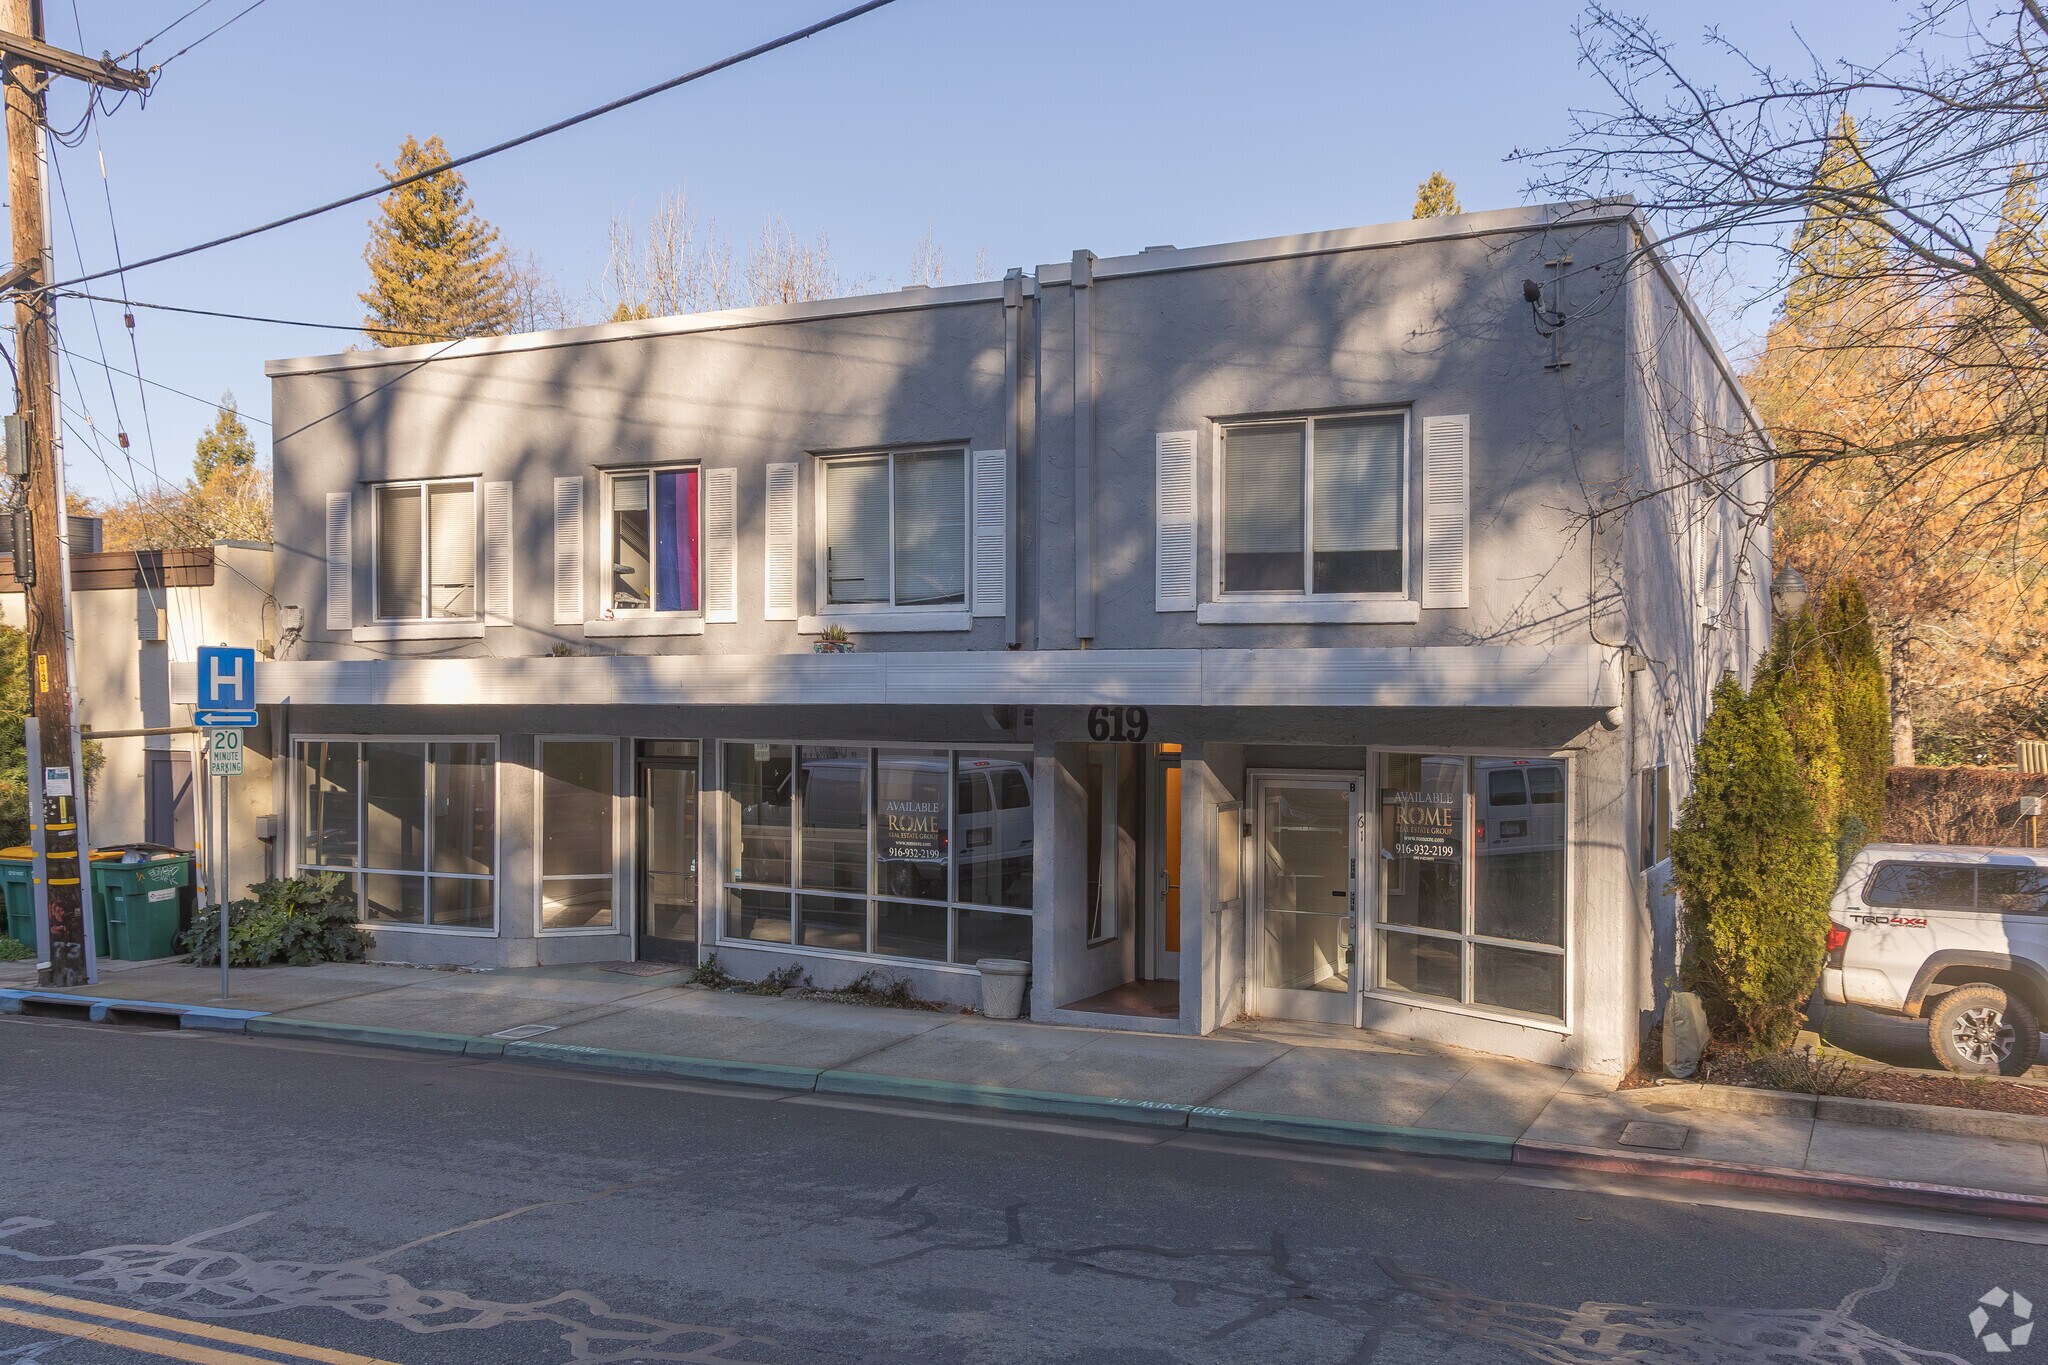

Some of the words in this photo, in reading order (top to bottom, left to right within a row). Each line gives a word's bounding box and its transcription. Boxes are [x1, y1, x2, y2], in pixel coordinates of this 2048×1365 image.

[210, 656, 243, 701] H
[1088, 705, 1148, 742] 619
[214, 732, 239, 749] 20
[213, 751, 239, 761] MINUTE
[211, 762, 241, 772] PARKING
[1349, 783, 1356, 792] B
[1393, 791, 1454, 804] AVAILABLE
[886, 801, 940, 813] AVAILABLE
[1396, 806, 1453, 827] ROME
[888, 814, 939, 833] ROME
[1431, 827, 1453, 835] GROUP
[888, 846, 940, 859] 916-932-2199
[1395, 843, 1454, 857] 916-932-2199
[1849, 914, 1890, 926] TRD
[1136, 1100, 1177, 1109] MIN
[1178, 1104, 1235, 1116] ZONE
[1888, 1179, 1920, 1189] NO
[1933, 1185, 2030, 1203] PARKING
